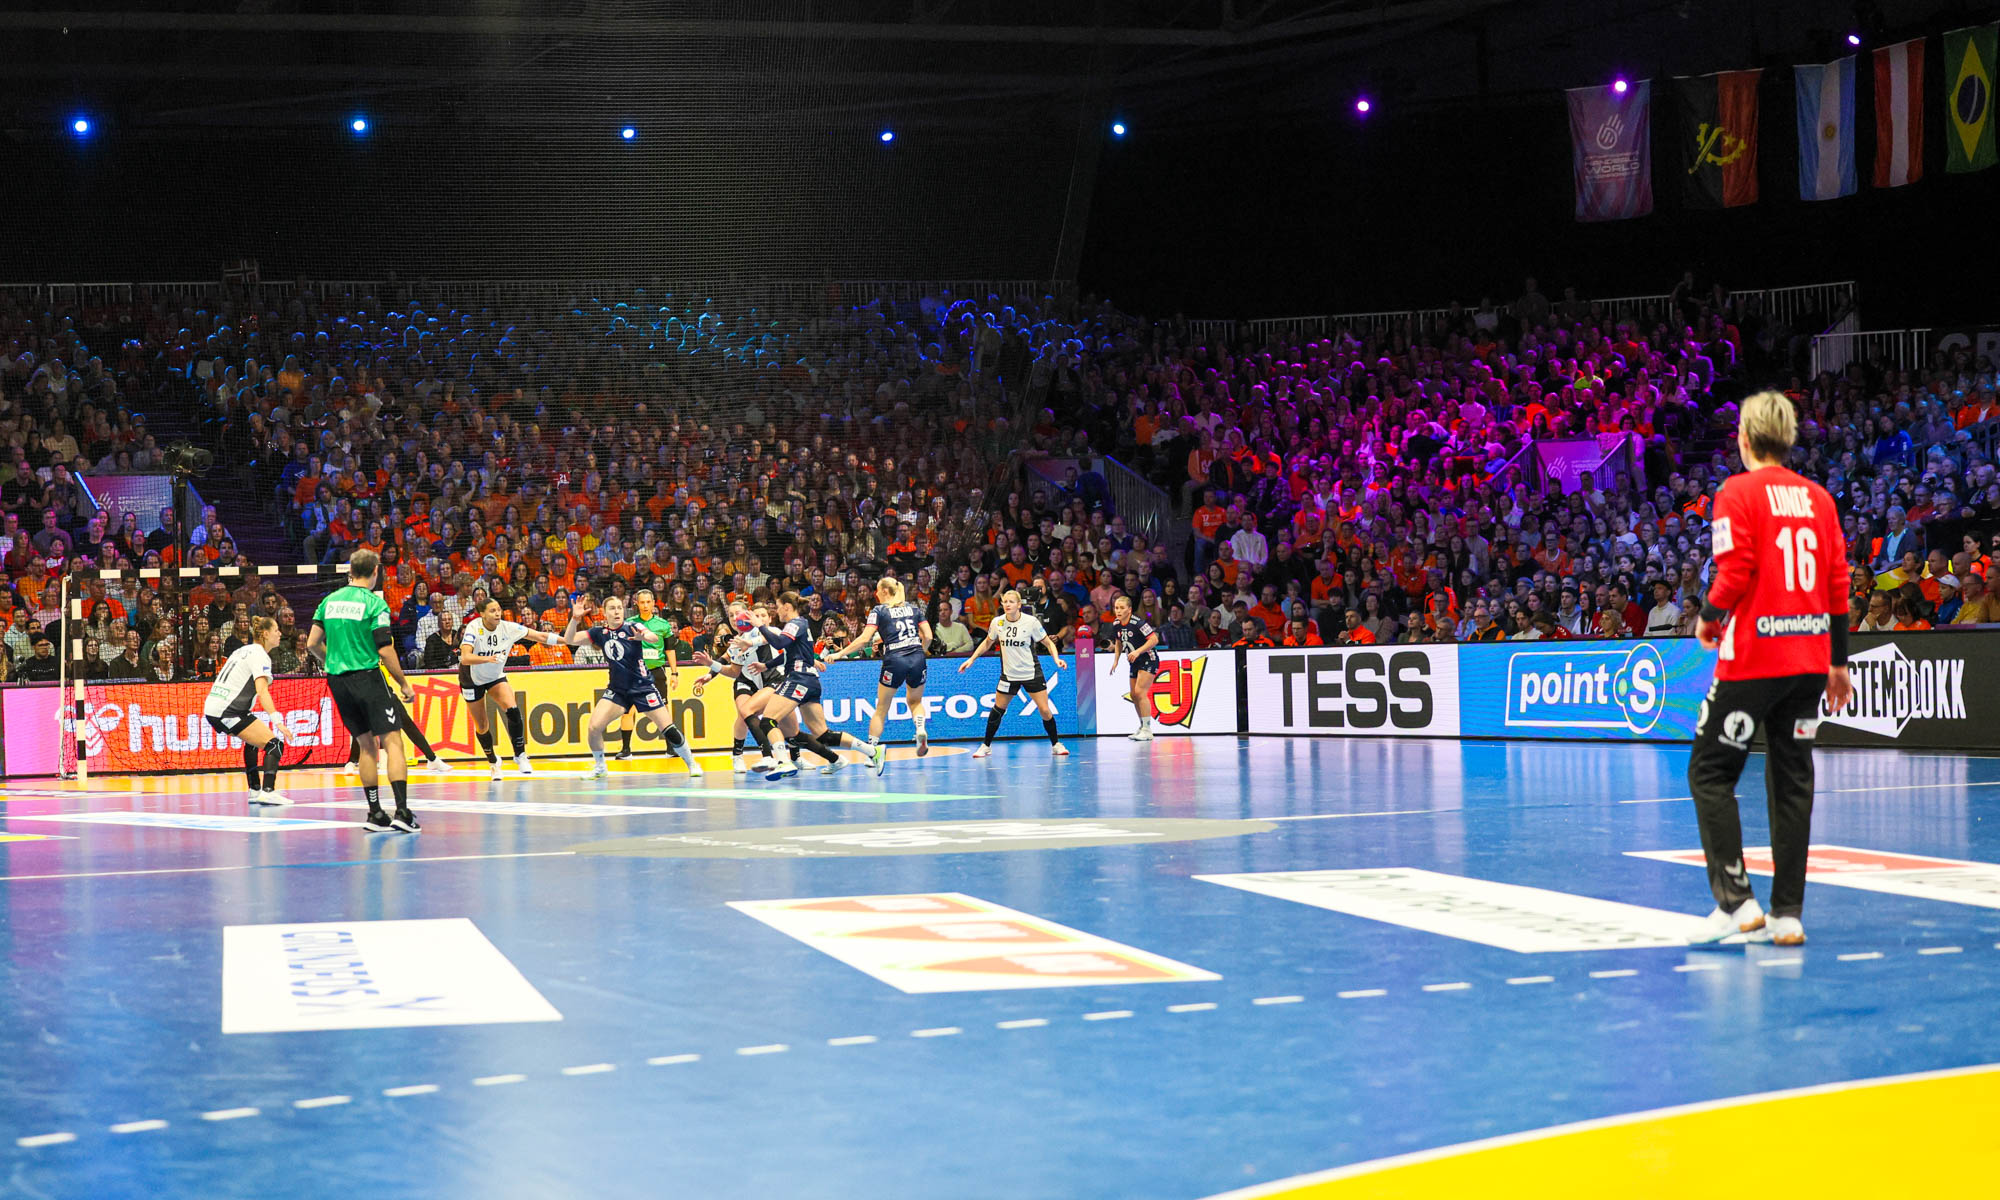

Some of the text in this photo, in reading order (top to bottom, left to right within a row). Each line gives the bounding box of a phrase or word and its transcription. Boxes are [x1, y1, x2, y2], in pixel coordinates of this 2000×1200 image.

[1766, 484, 1815, 518] LUNDE
[1775, 526, 1818, 592] 16
[487, 634, 498, 647] 49
[896, 619, 917, 641] 25
[1001, 639, 1026, 647] atlas
[1006, 626, 1018, 638] 29
[1268, 651, 1433, 729] TESS
[1519, 662, 1610, 713] point
[1630, 659, 1657, 714] S
[1821, 659, 1967, 719] STEMBLOKK
[793, 694, 1001, 725] UNDFOS
